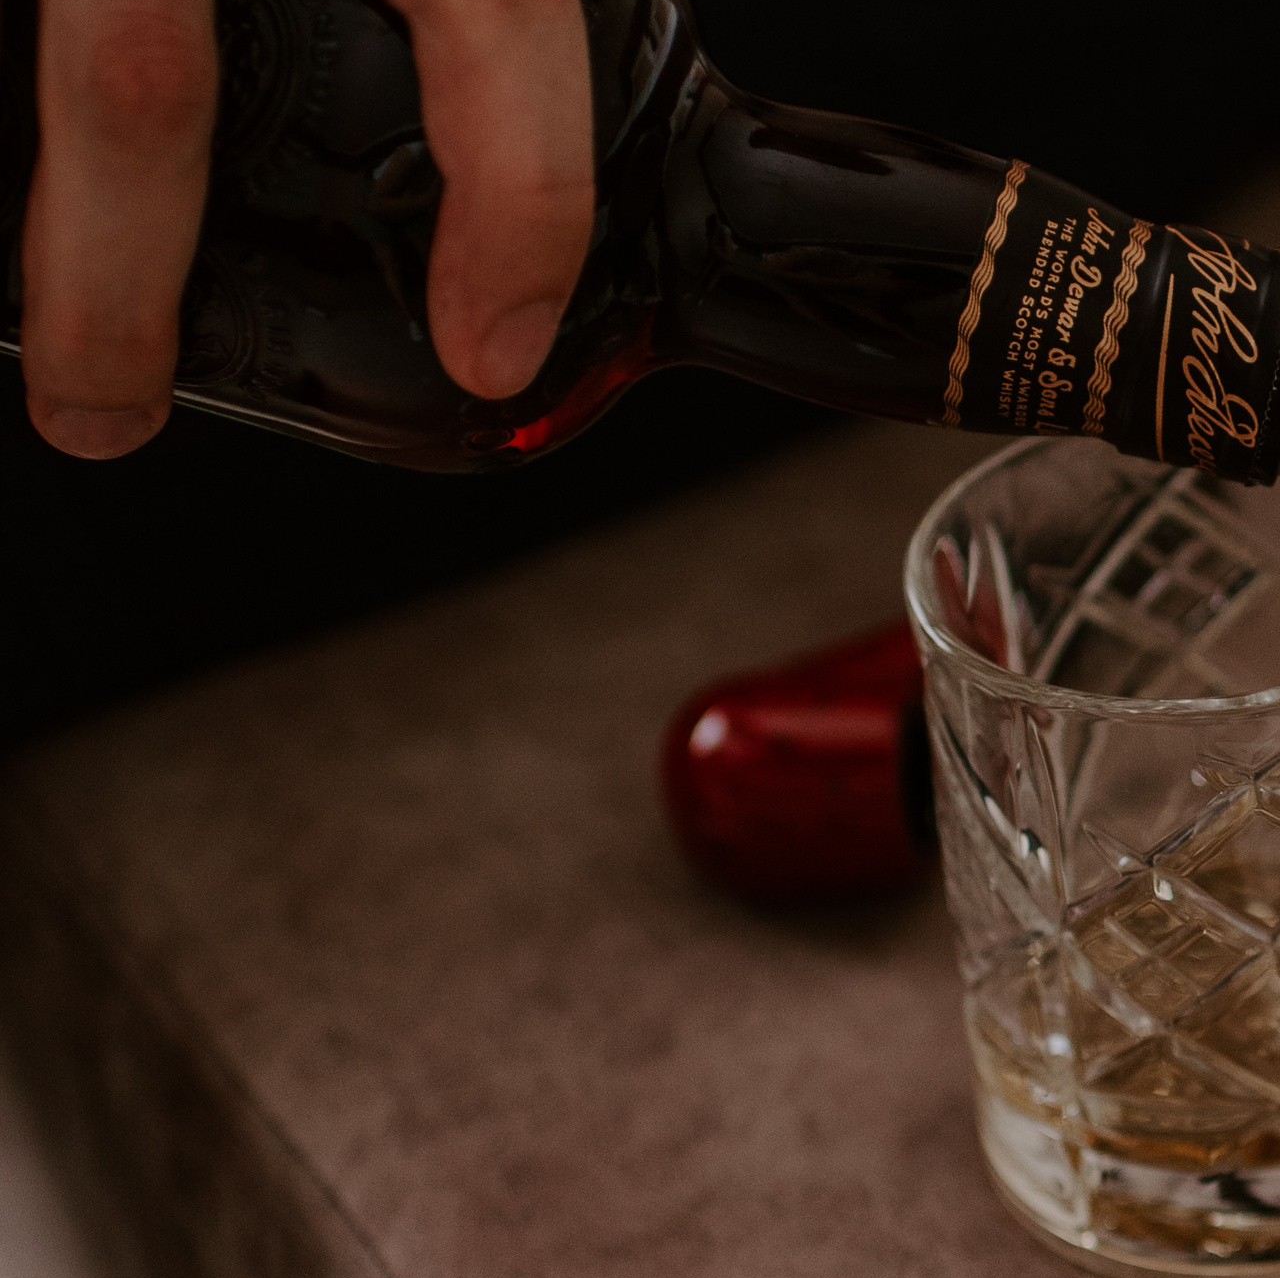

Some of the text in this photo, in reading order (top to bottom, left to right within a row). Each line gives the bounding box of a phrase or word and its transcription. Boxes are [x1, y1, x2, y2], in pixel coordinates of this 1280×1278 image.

[1080, 207, 1116, 256] John
[998, 219, 1059, 418] BLENDED SCOTCH WHISKY
[1014, 217, 1078, 427] THE WORLD'S MOST AWARDED
[1055, 254, 1103, 344] Dewar
[1164, 224, 1259, 364] John
[1037, 370, 1074, 418] Sons
[1047, 347, 1077, 369] &
